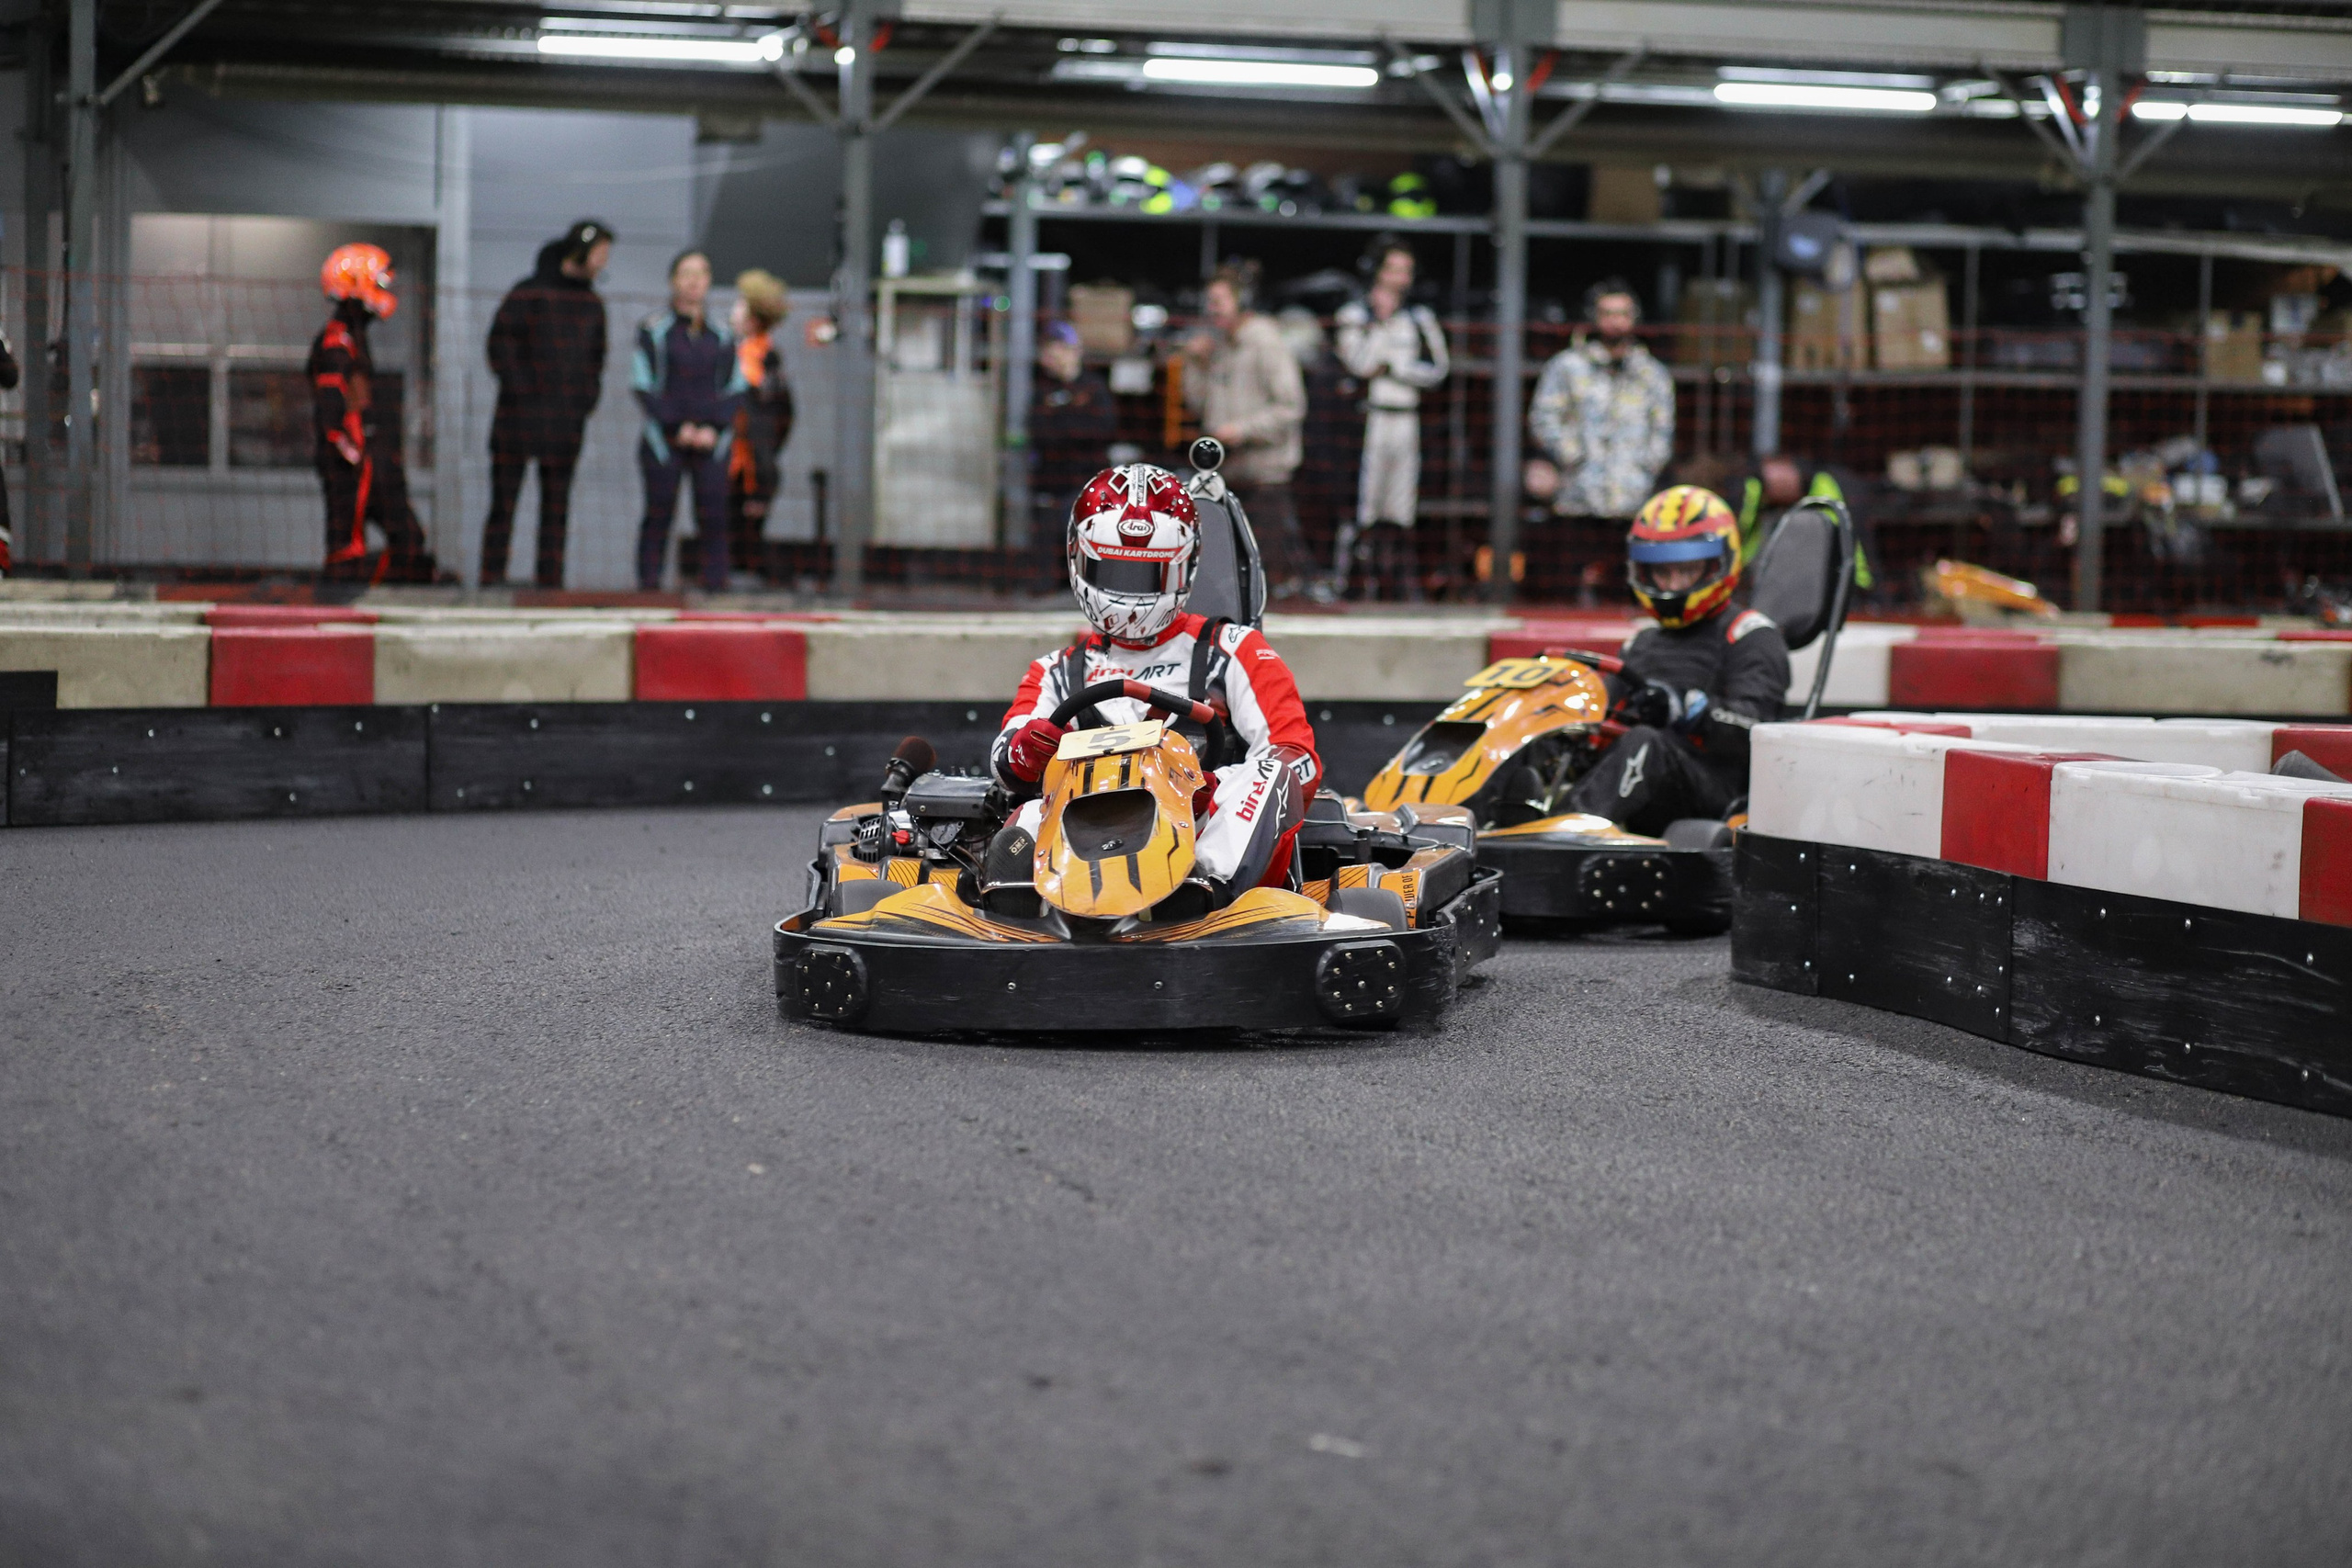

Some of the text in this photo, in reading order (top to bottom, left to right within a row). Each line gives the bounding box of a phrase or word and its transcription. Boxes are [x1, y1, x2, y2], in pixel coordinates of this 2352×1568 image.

[1097, 547, 1124, 557] DUBAI
[1124, 549, 1176, 558] KARTDROME
[1486, 665, 1554, 682] 10
[1087, 728, 1131, 750] 5
[1010, 837, 1027, 854] OMP
[1401, 874, 1414, 884] OF
